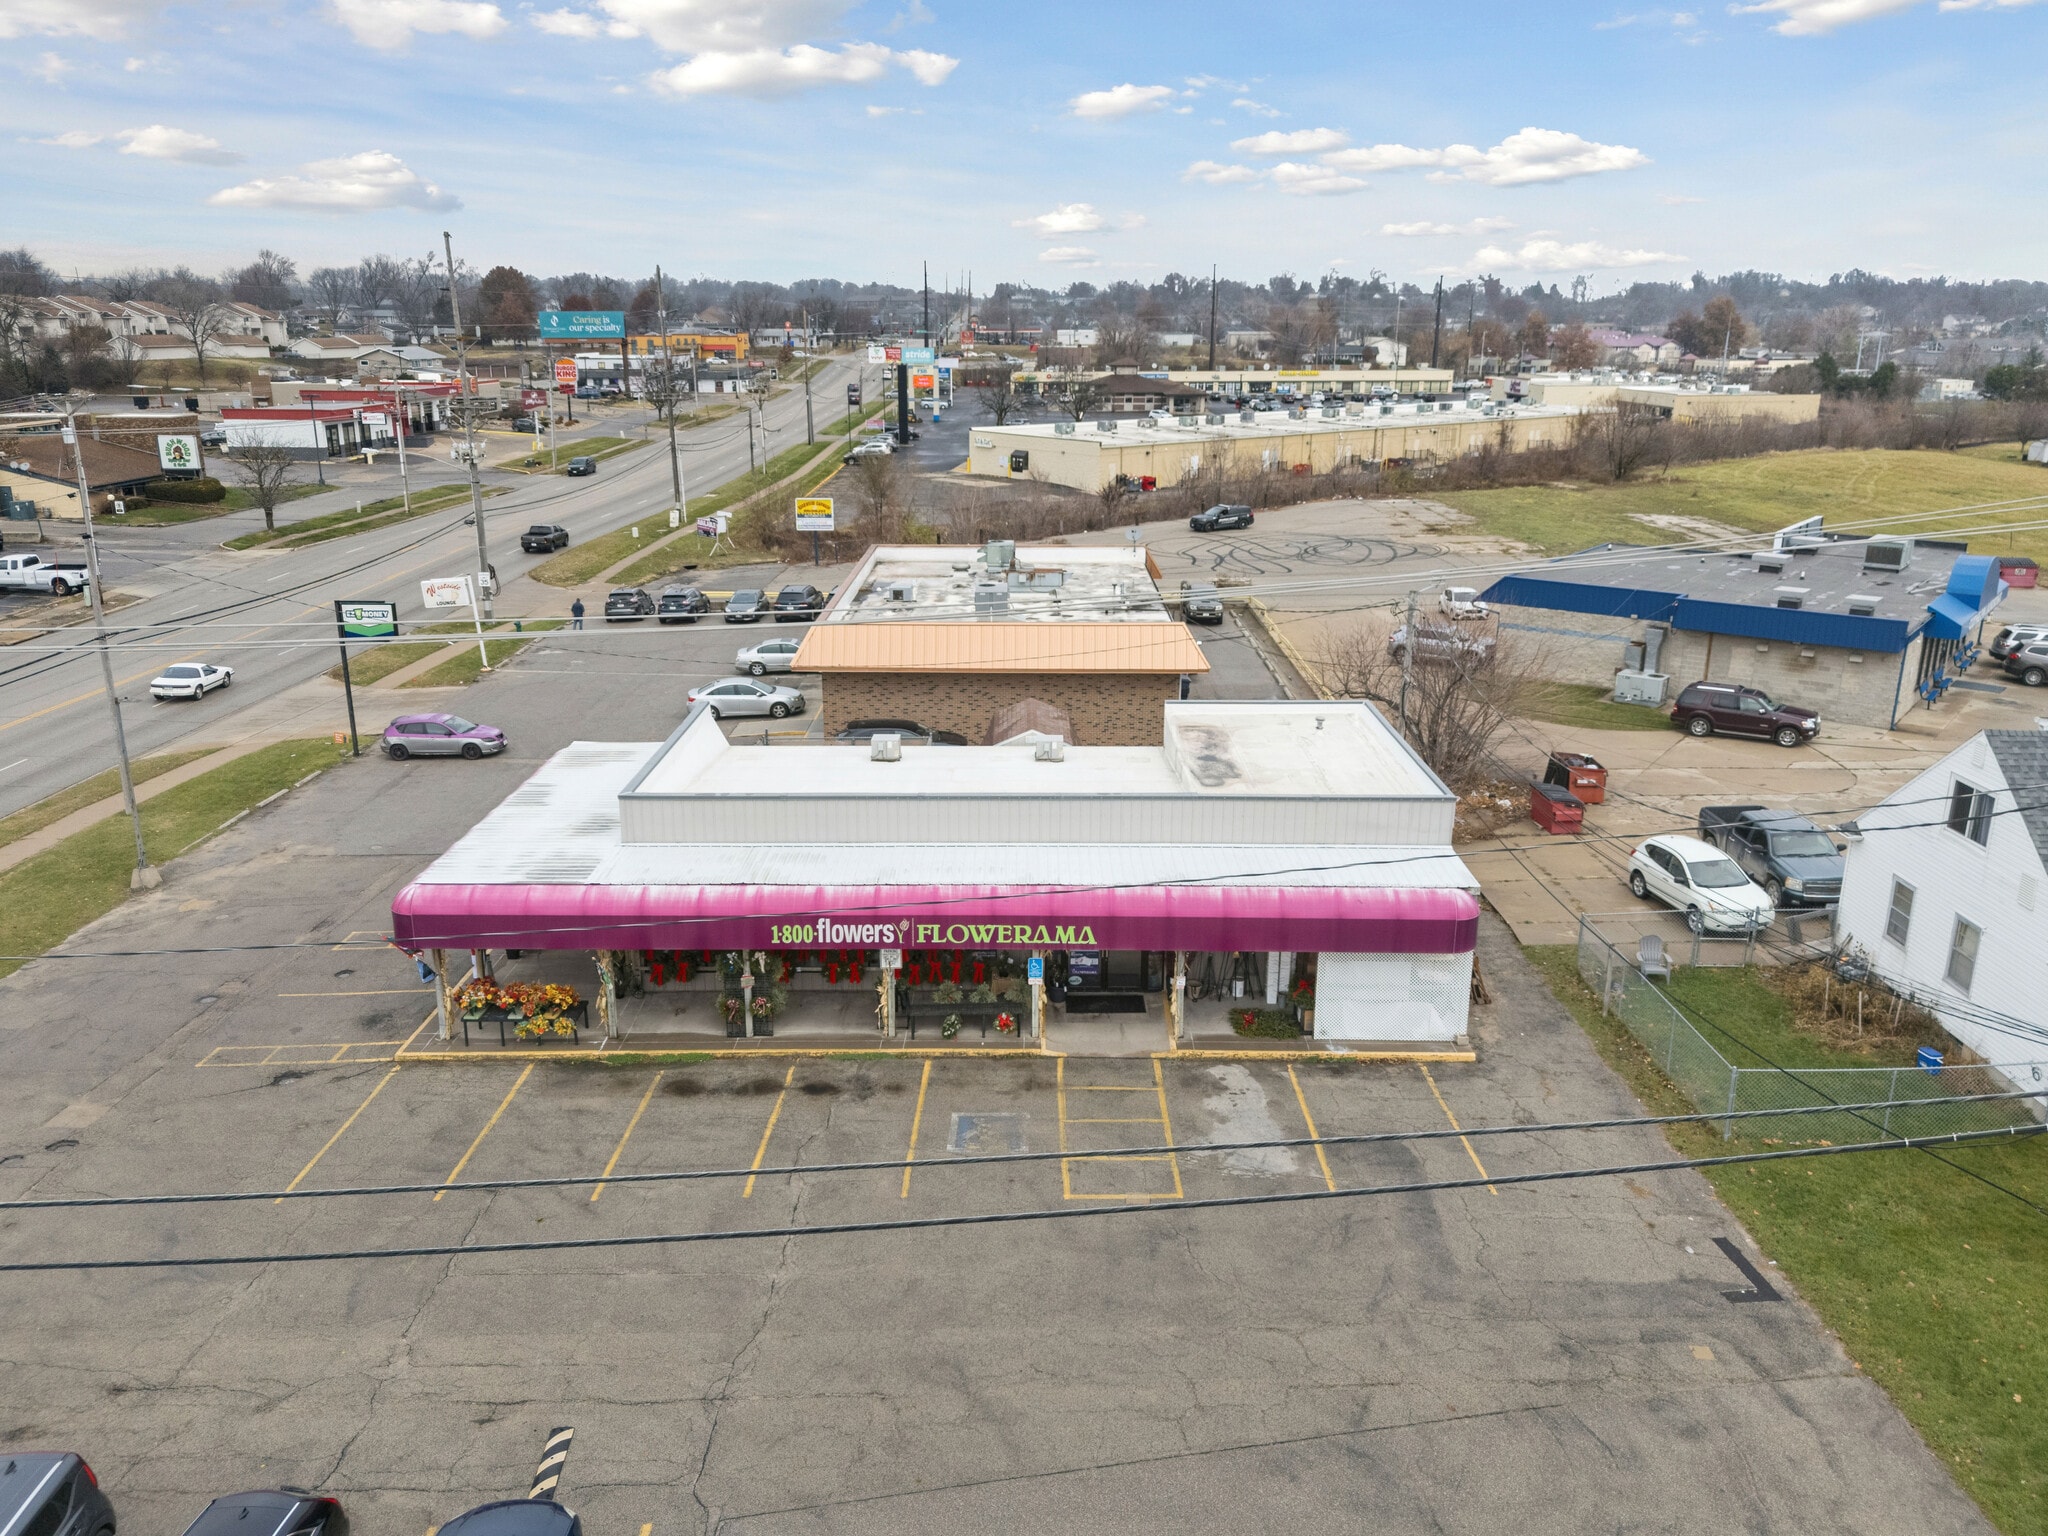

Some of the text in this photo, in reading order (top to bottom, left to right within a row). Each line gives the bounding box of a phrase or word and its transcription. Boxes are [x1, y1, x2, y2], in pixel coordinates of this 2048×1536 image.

[573, 315, 610, 326] Caring is
[568, 324, 583, 332] our
[584, 323, 621, 334] specialty
[905, 350, 931, 359] stride
[361, 610, 389, 619] MONEY
[916, 924, 1098, 945] FLOWERAMA
